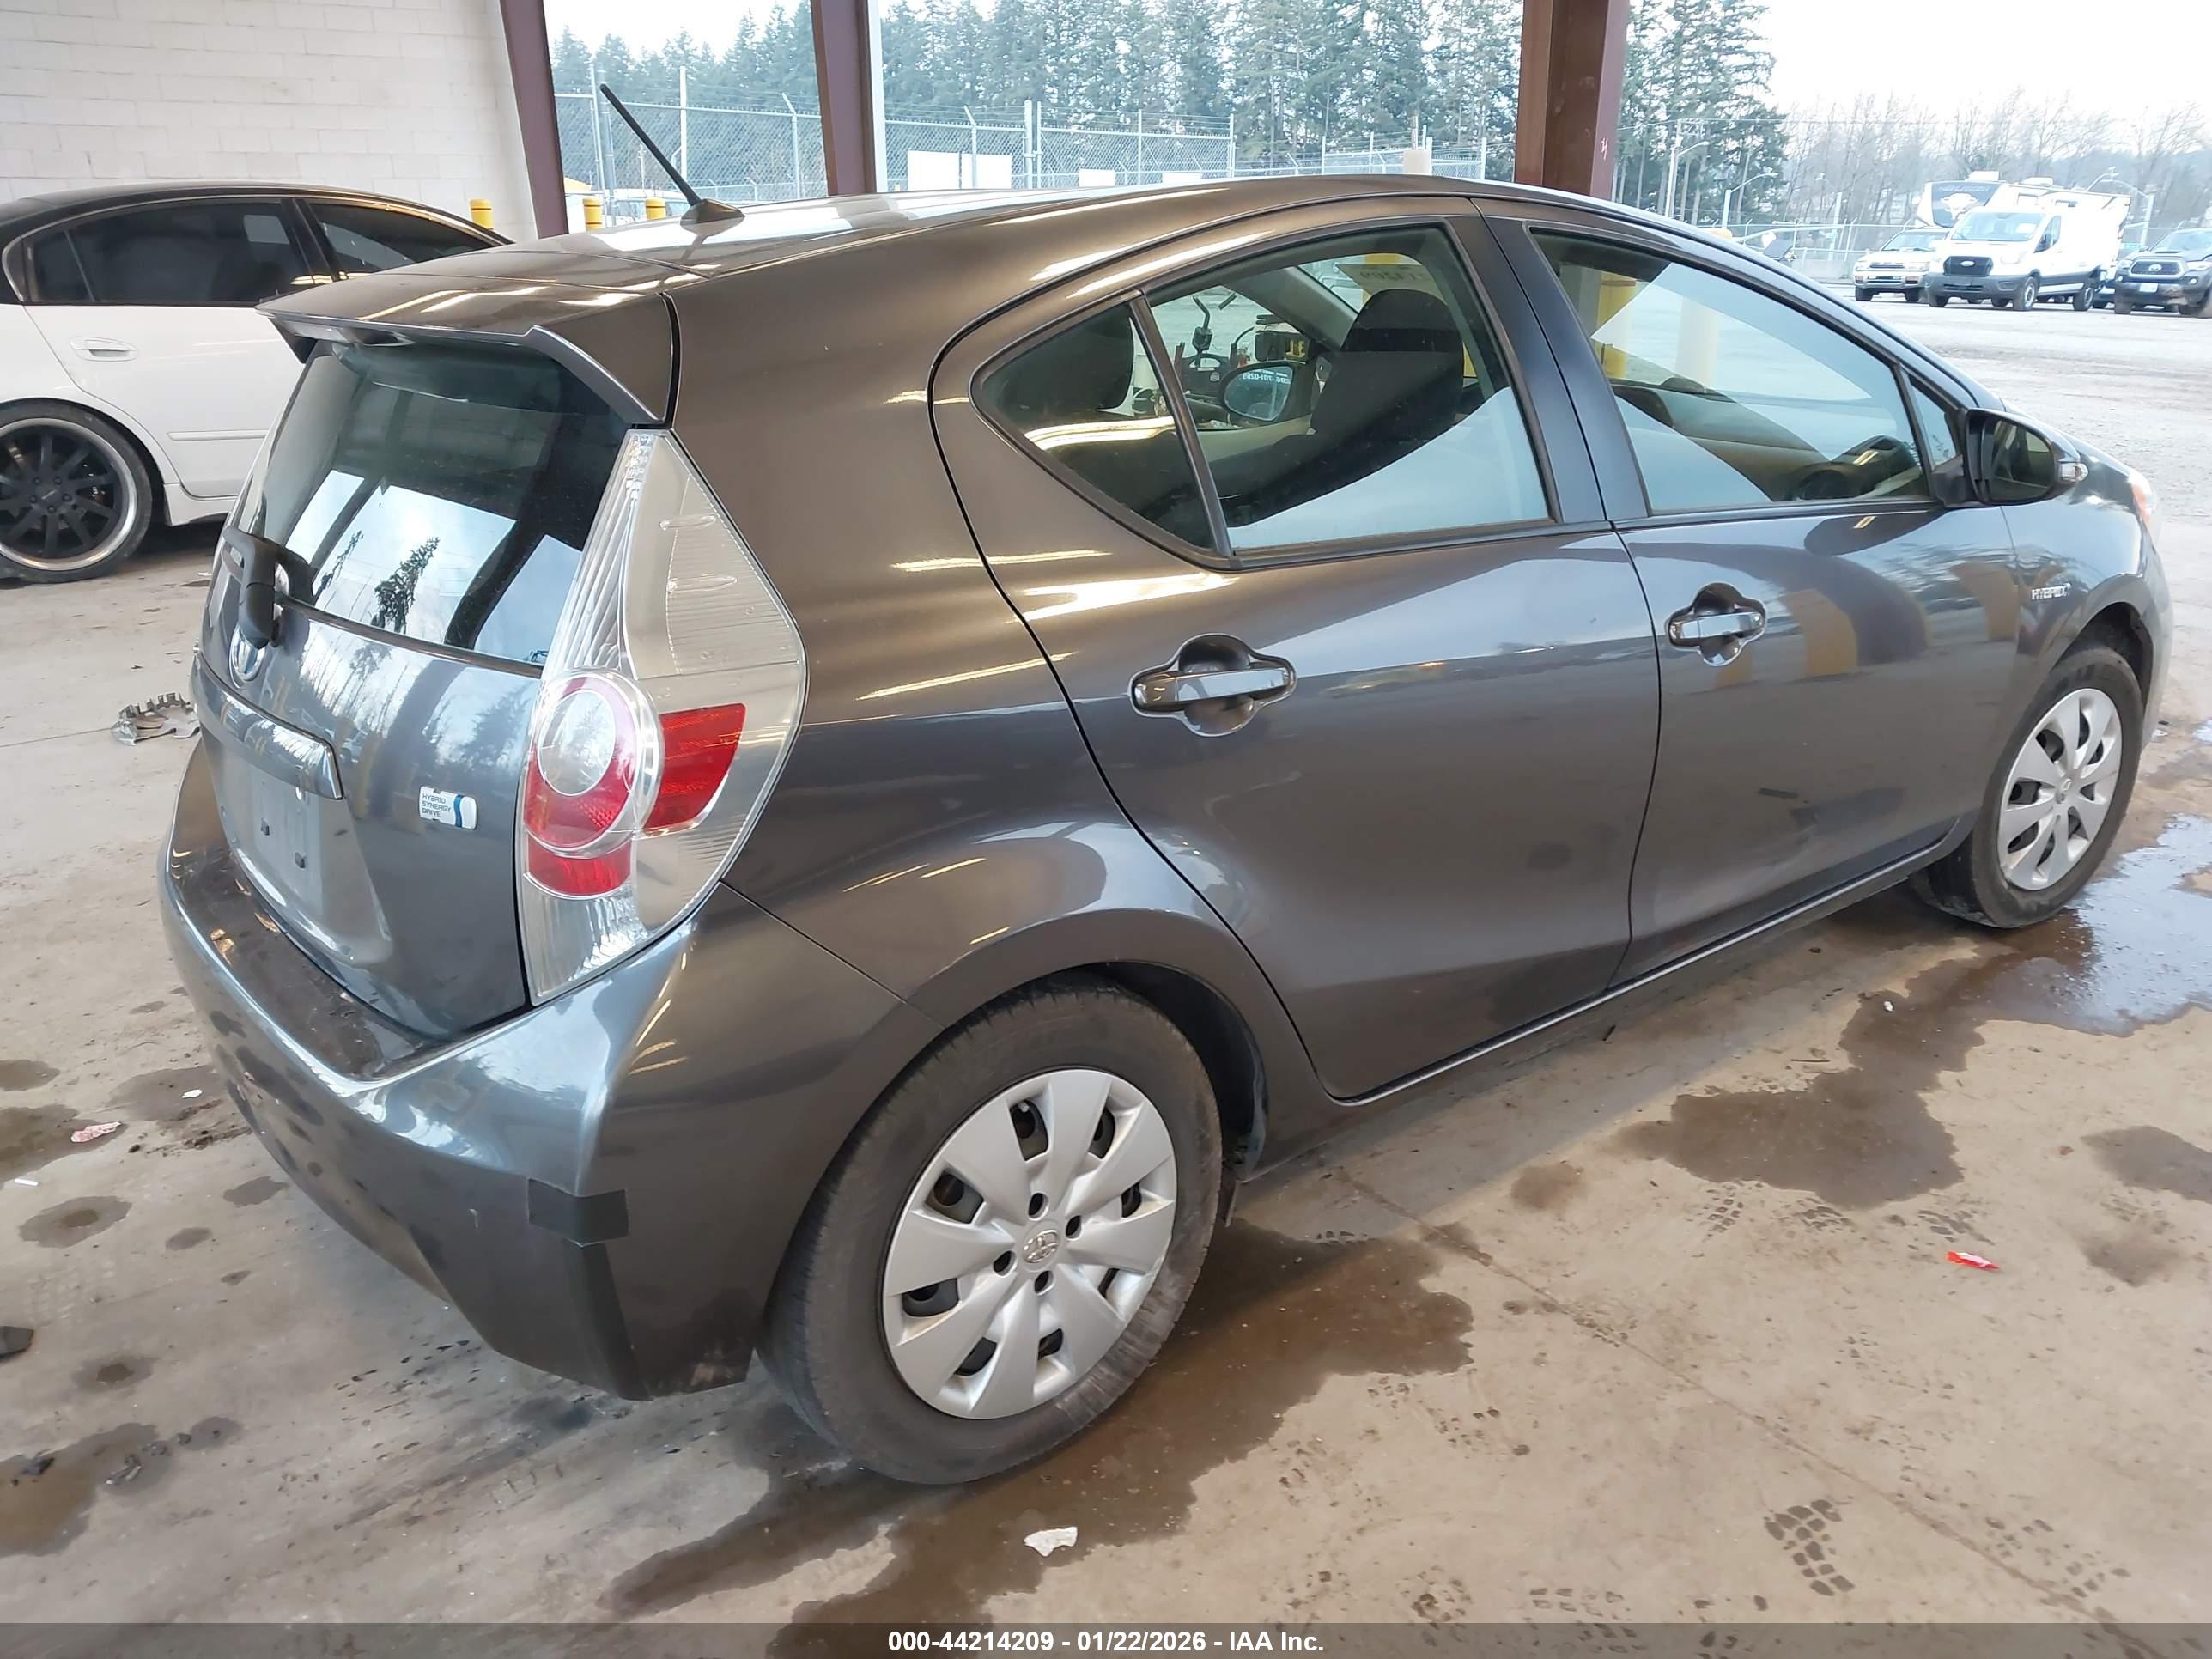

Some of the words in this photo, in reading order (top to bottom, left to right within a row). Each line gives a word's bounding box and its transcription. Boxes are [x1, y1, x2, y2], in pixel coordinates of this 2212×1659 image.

[422, 793, 447, 804] HYBRID
[422, 800, 452, 812] SYNERGY
[422, 807, 441, 817] DRIVE
